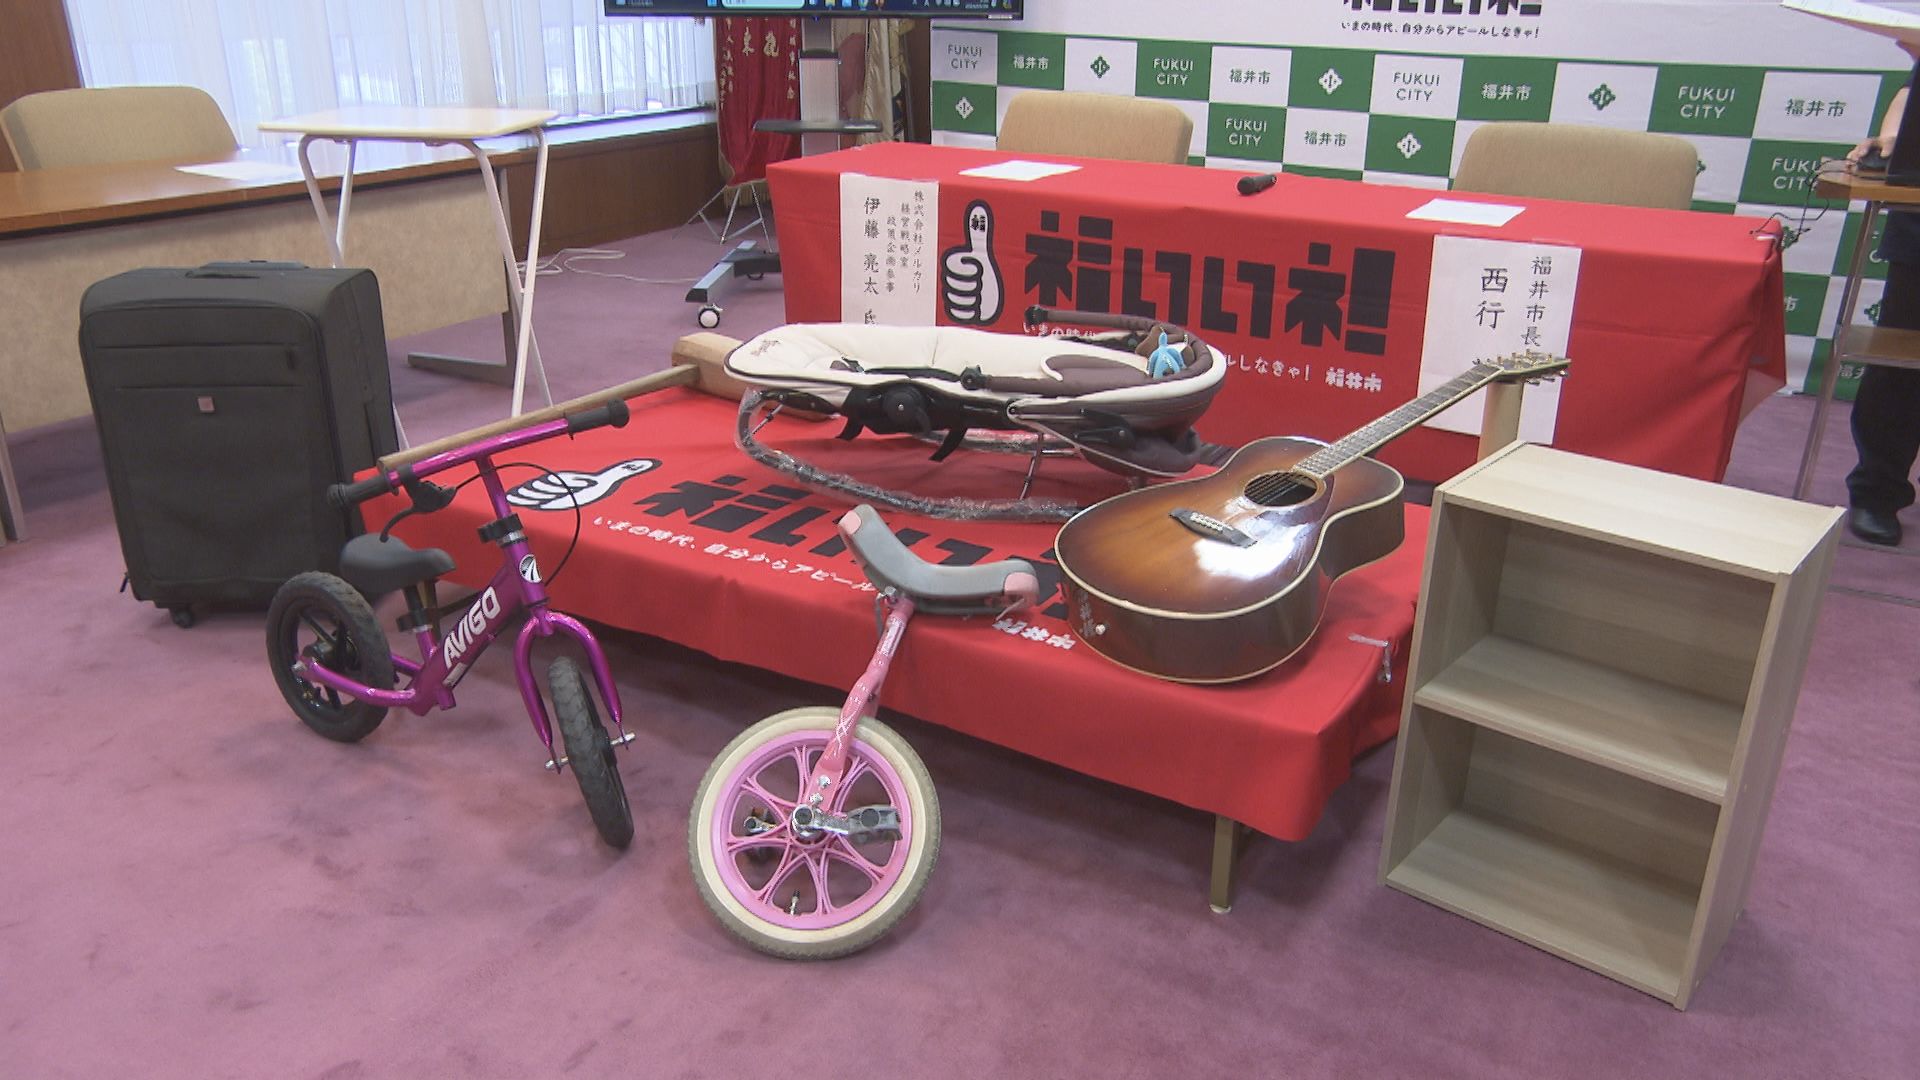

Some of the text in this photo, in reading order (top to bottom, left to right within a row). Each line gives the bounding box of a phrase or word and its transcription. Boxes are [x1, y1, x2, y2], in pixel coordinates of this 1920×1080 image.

[947, 44, 982, 58] FUKUI
[950, 58, 978, 70] CITY
[1013, 54, 1049, 71] 福井市
[1153, 58, 1194, 71] FUKUI
[1156, 72, 1189, 86] CITY
[1229, 68, 1271, 85] 福井市
[1393, 71, 1440, 87] FUKUI
[1396, 88, 1433, 102] CITY
[1481, 83, 1531, 101] 福井市
[1678, 85, 1736, 103] FUKUI
[1679, 103, 1726, 120] CITY
[1785, 98, 1847, 118] 福井市
[1225, 118, 1267, 132] FUKUI
[1228, 132, 1261, 145] CITY
[1304, 129, 1347, 147] 福井市
[864, 196, 881, 239] 伊藤
[863, 253, 880, 296] 亮太
[1475, 267, 1509, 330] 西行
[1520, 255, 1553, 347] 福井市長
[444, 586, 501, 670] AVIGO
